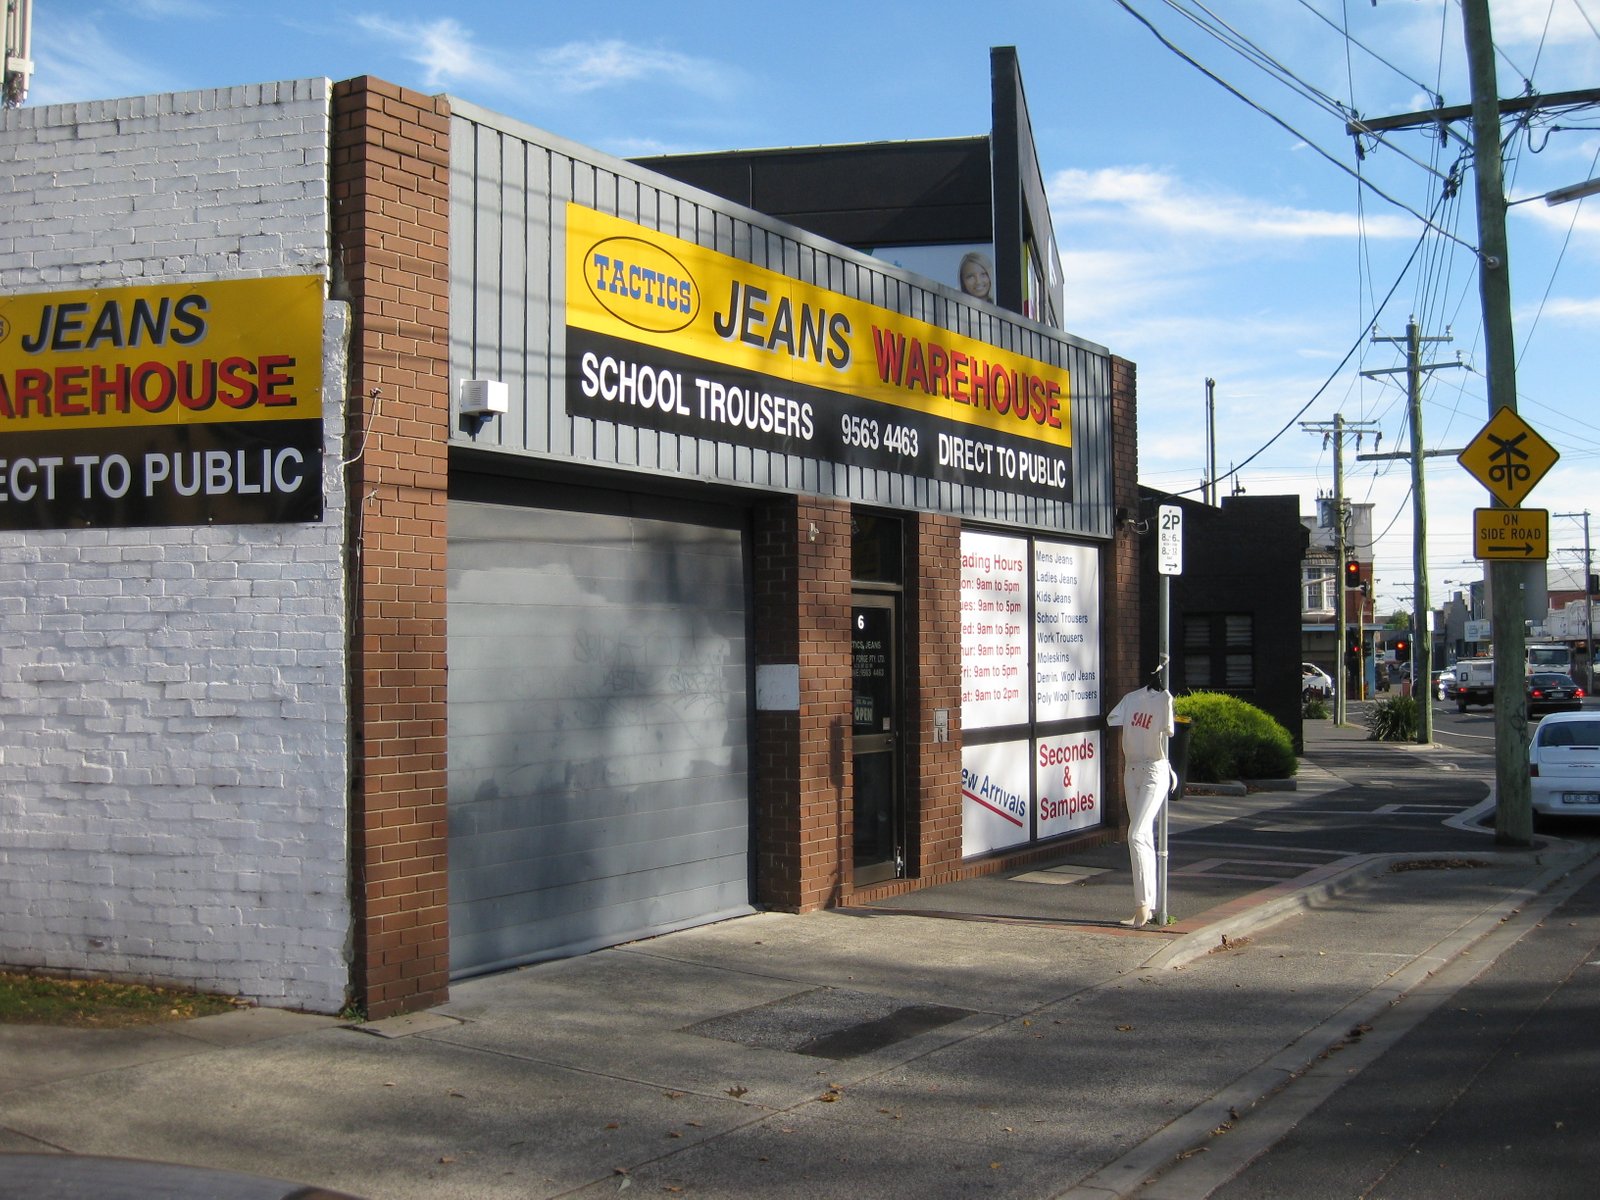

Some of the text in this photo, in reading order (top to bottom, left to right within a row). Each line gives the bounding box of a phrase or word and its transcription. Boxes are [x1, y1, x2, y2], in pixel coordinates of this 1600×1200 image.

[594, 253, 691, 314] TACTICS
[21, 294, 212, 355] JEANS
[714, 280, 1062, 429] JEANS WAREHOUSE
[581, 352, 1066, 488] SCHOOL TROUSERS 9563 4463 DIRECT TO PUBLIC
[74, 454, 131, 499] TO
[145, 447, 304, 497] PUBLIC
[1162, 514, 1180, 530] 2P
[1503, 514, 1518, 526] ON
[1481, 528, 1540, 540] SIDE ROAD
[960, 553, 1022, 573] ading Hours
[1036, 550, 1074, 565] Mens Jeans
[961, 578, 1020, 594] on: 9am to 5pm
[1036, 572, 1078, 585] Ladies Jeans
[1036, 591, 1072, 604] Kids Jeans
[960, 600, 1021, 614] ues: 9am to 5pm
[858, 615, 864, 629] 6
[1036, 612, 1088, 624] School Trousers
[960, 622, 1020, 637] ed: 9am to 5pm
[1038, 632, 1084, 644] Work Trousers
[978, 644, 994, 656] 9am
[996, 644, 1004, 656] to
[1006, 644, 1021, 658] 5pm
[1038, 652, 1070, 664] Moleskins
[961, 664, 1018, 678] ri: 9am to 5pm
[1061, 671, 1076, 682] Wool
[1078, 670, 1096, 681] Jeans
[961, 688, 1019, 702] at: 9am to 2pm
[1038, 690, 1098, 705] Poly Wool Trousers
[854, 706, 872, 720] OPEN
[1131, 712, 1153, 730] SALE
[1040, 738, 1094, 767] Seconds
[1064, 766, 1072, 788] &
[961, 768, 1026, 817] ew Arrivals
[1040, 791, 1094, 820] Samples
